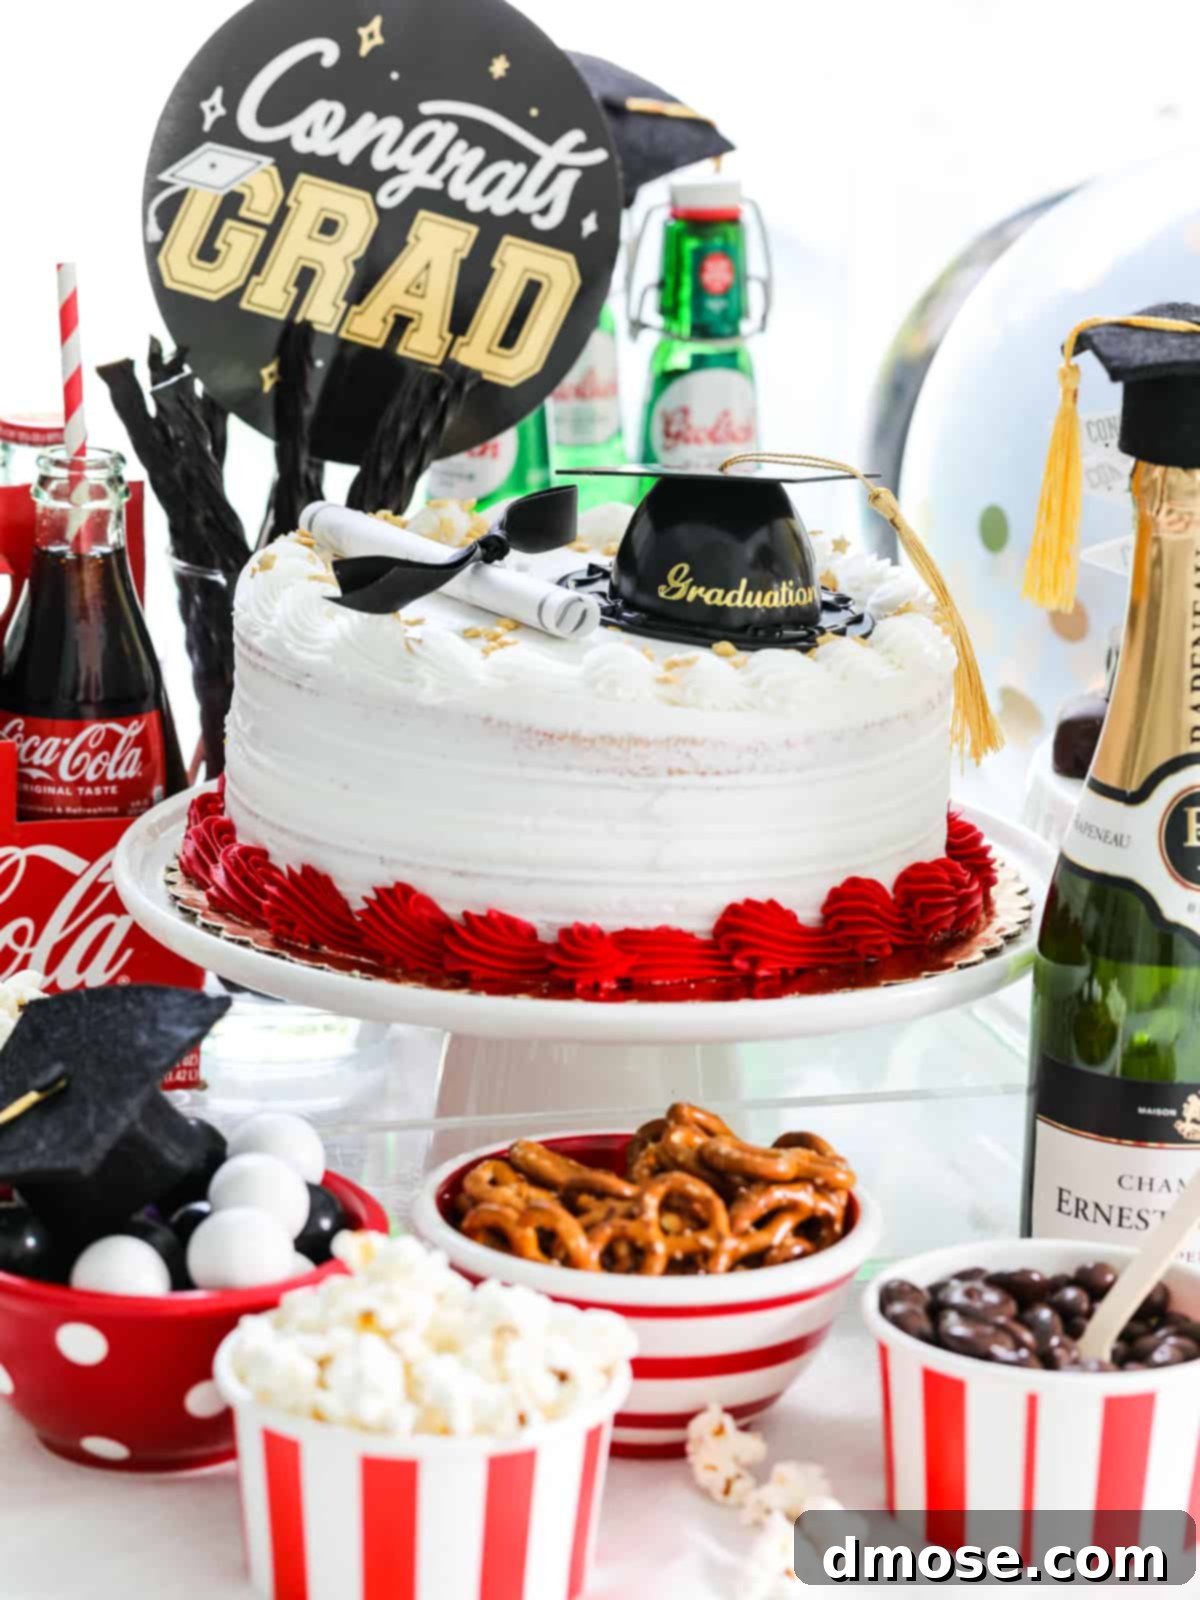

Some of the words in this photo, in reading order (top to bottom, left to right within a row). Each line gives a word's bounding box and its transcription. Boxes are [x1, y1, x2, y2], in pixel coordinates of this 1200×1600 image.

[237, 38, 608, 230] Congrats
[158, 166, 581, 387] GRAD
[1086, 416, 1120, 443] CON
[658, 563, 817, 608] Graduation
[19, 783, 73, 797] RIGINAL
[77, 785, 118, 796] TASTE
[0, 844, 134, 991] ola
[1138, 1106, 1177, 1117] MAISON
